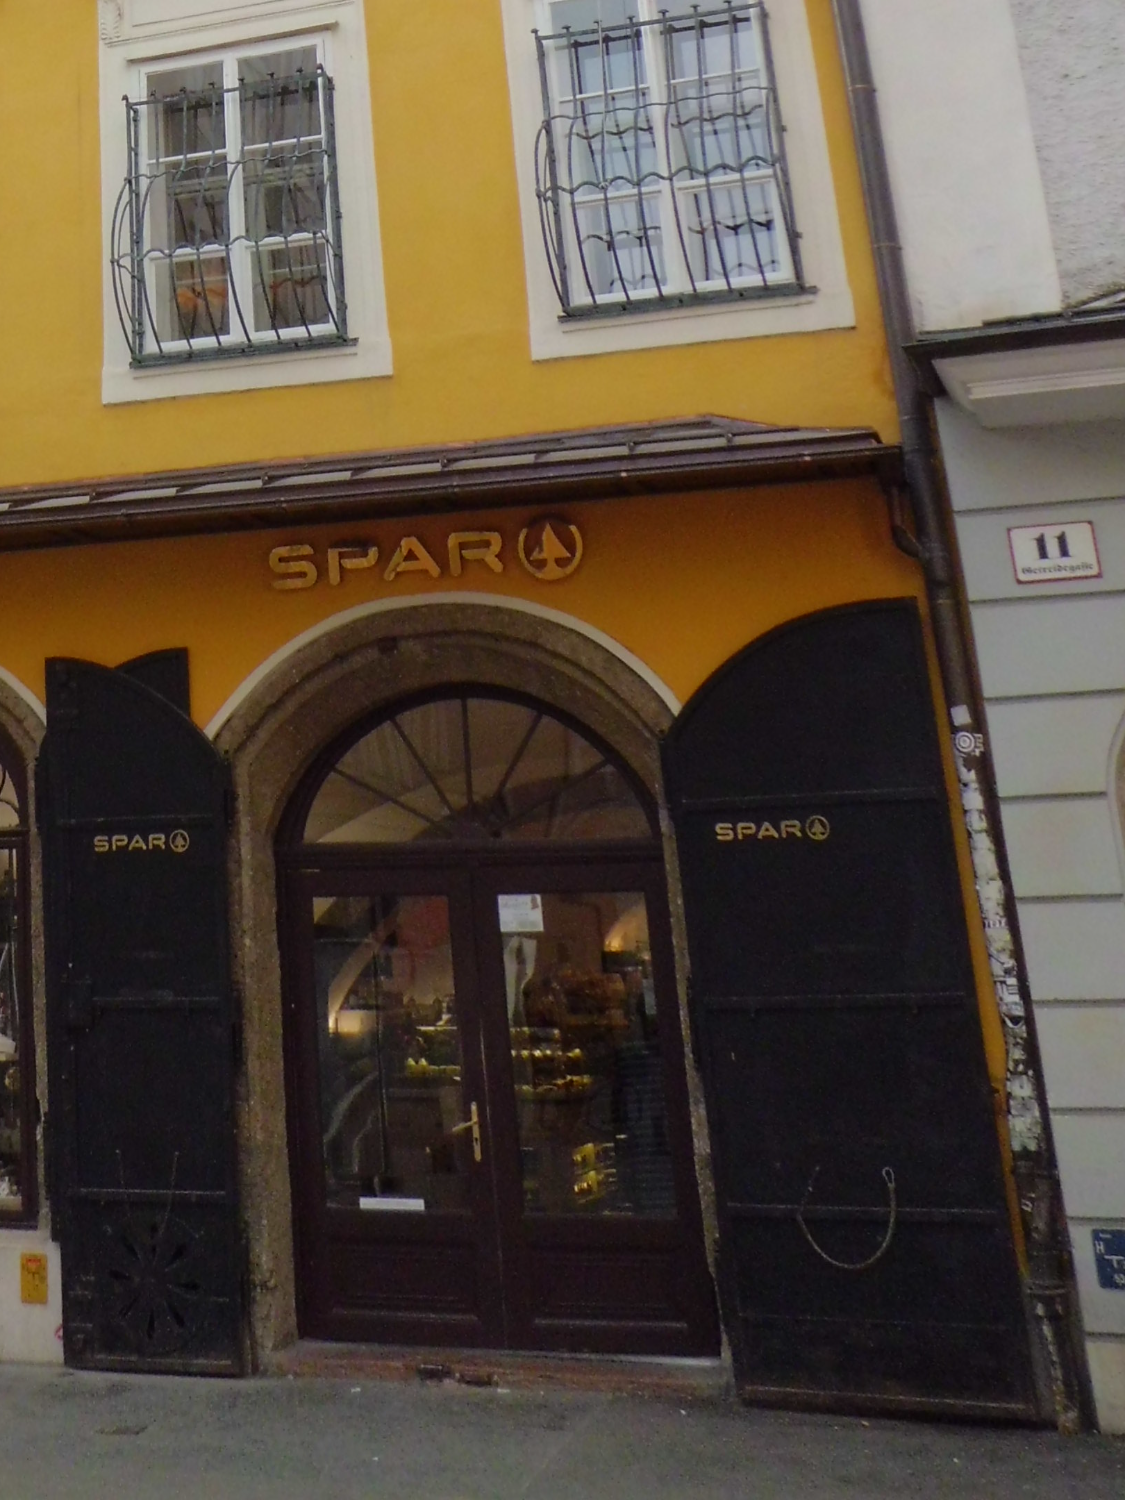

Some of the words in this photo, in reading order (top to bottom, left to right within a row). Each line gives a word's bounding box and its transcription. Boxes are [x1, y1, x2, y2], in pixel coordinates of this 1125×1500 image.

[1031, 530, 1073, 560] 11
[268, 530, 504, 591] SPAR
[93, 833, 166, 852] SPAR
[715, 819, 803, 841] SPAR
